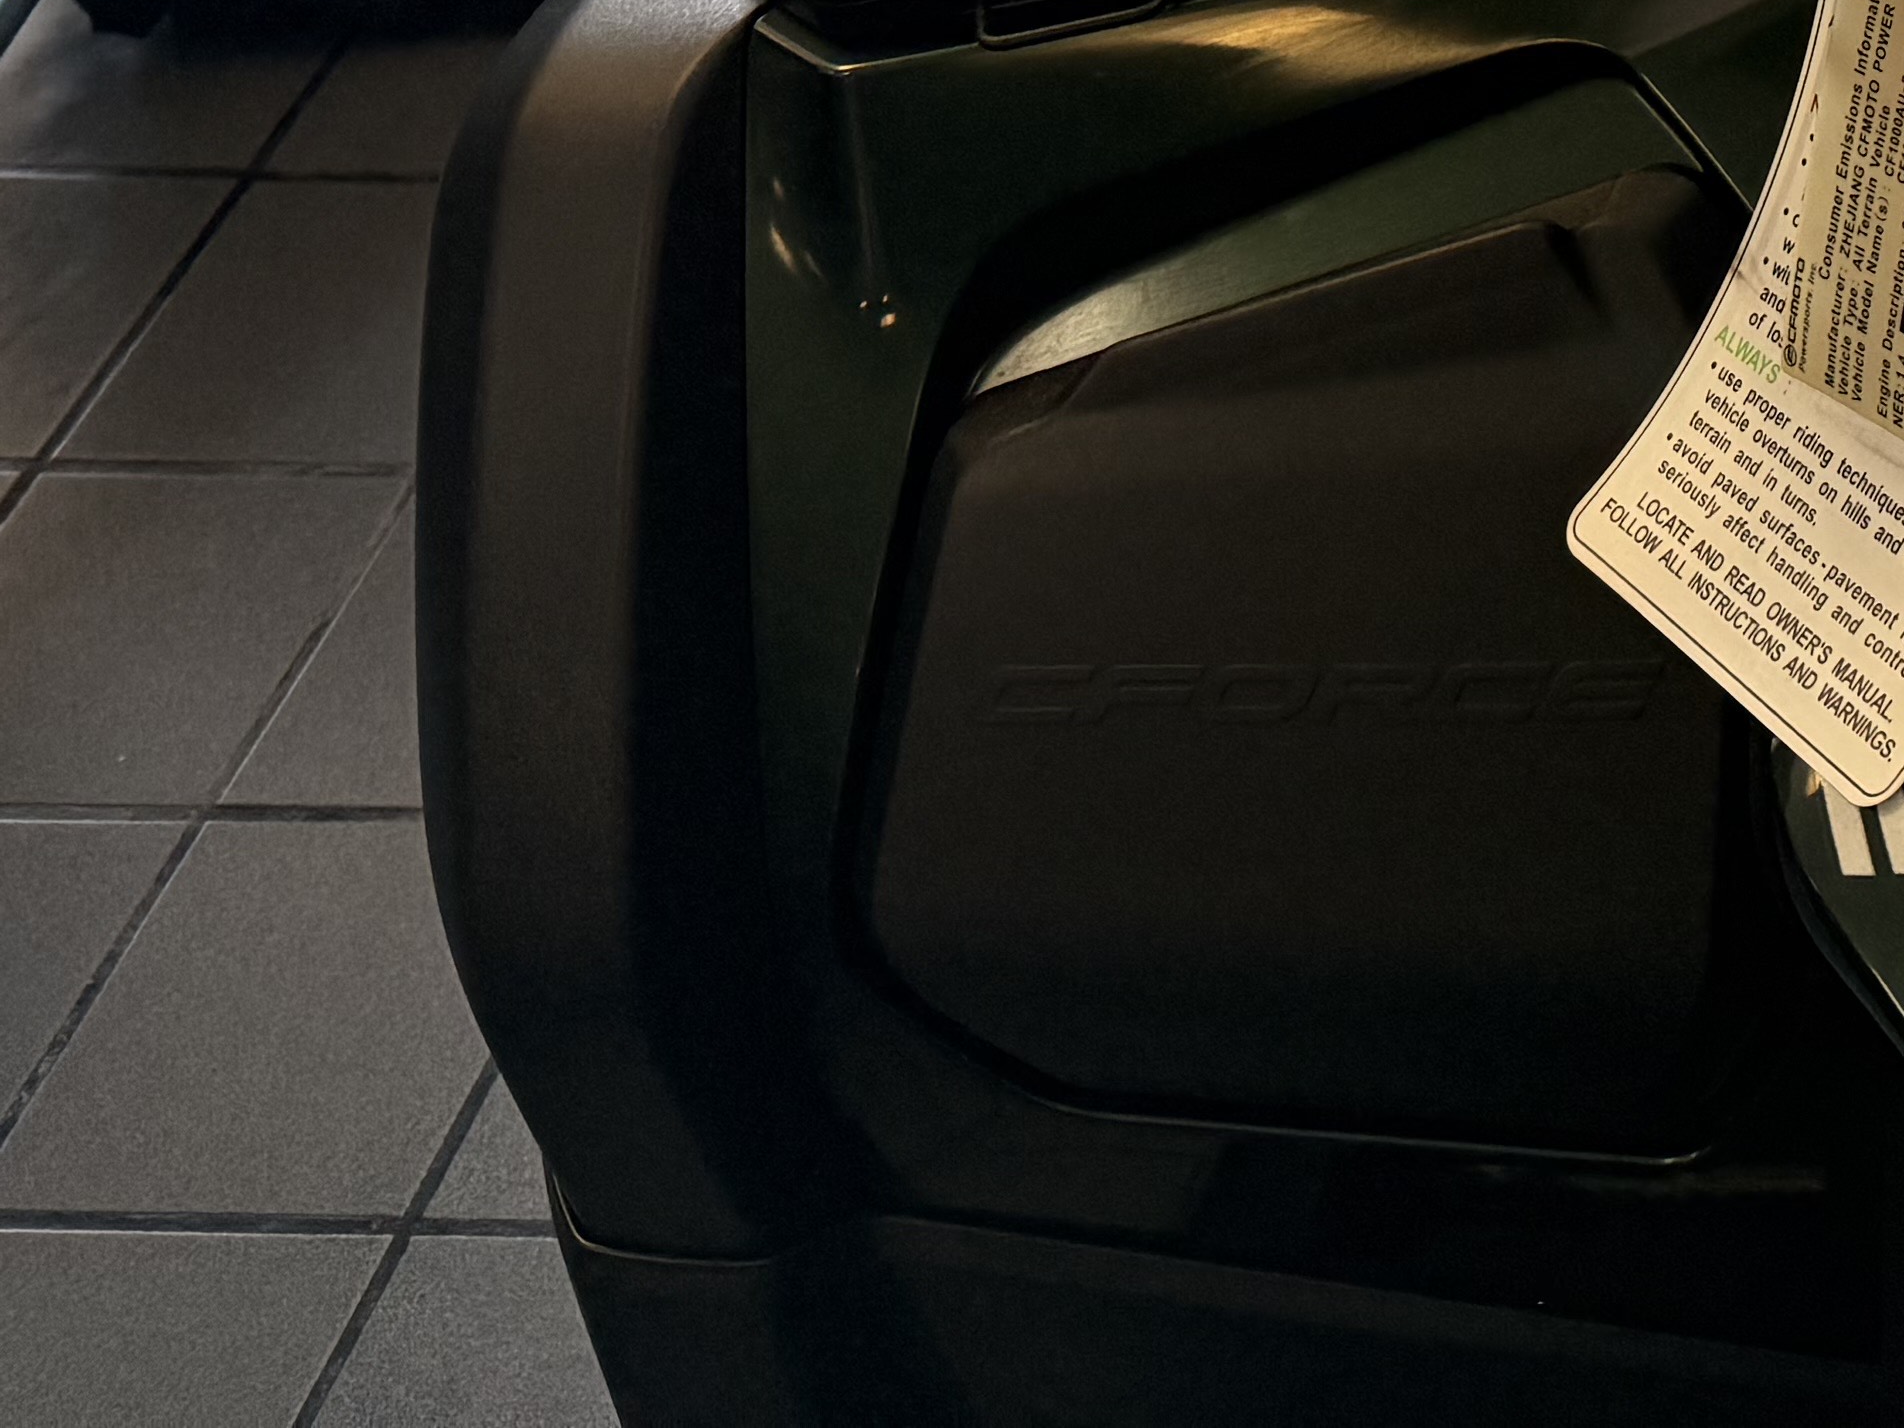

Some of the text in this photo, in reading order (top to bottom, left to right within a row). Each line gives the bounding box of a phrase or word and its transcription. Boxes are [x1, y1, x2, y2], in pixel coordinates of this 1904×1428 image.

[1818, 185, 1844, 280] Consumer
[1837, 81, 1863, 180] Emissions
[1714, 325, 1781, 385] ALWAYS
[1717, 366, 1743, 393] use
[1742, 388, 1792, 430] proper
[1792, 425, 1834, 469] riding
[1600, 497, 1897, 763] FOLLOW ALL INSTRUCTIONS AND WARNINGS.
[1636, 491, 1893, 724] LOCATE AND READ OWNER'S MANUAL.
